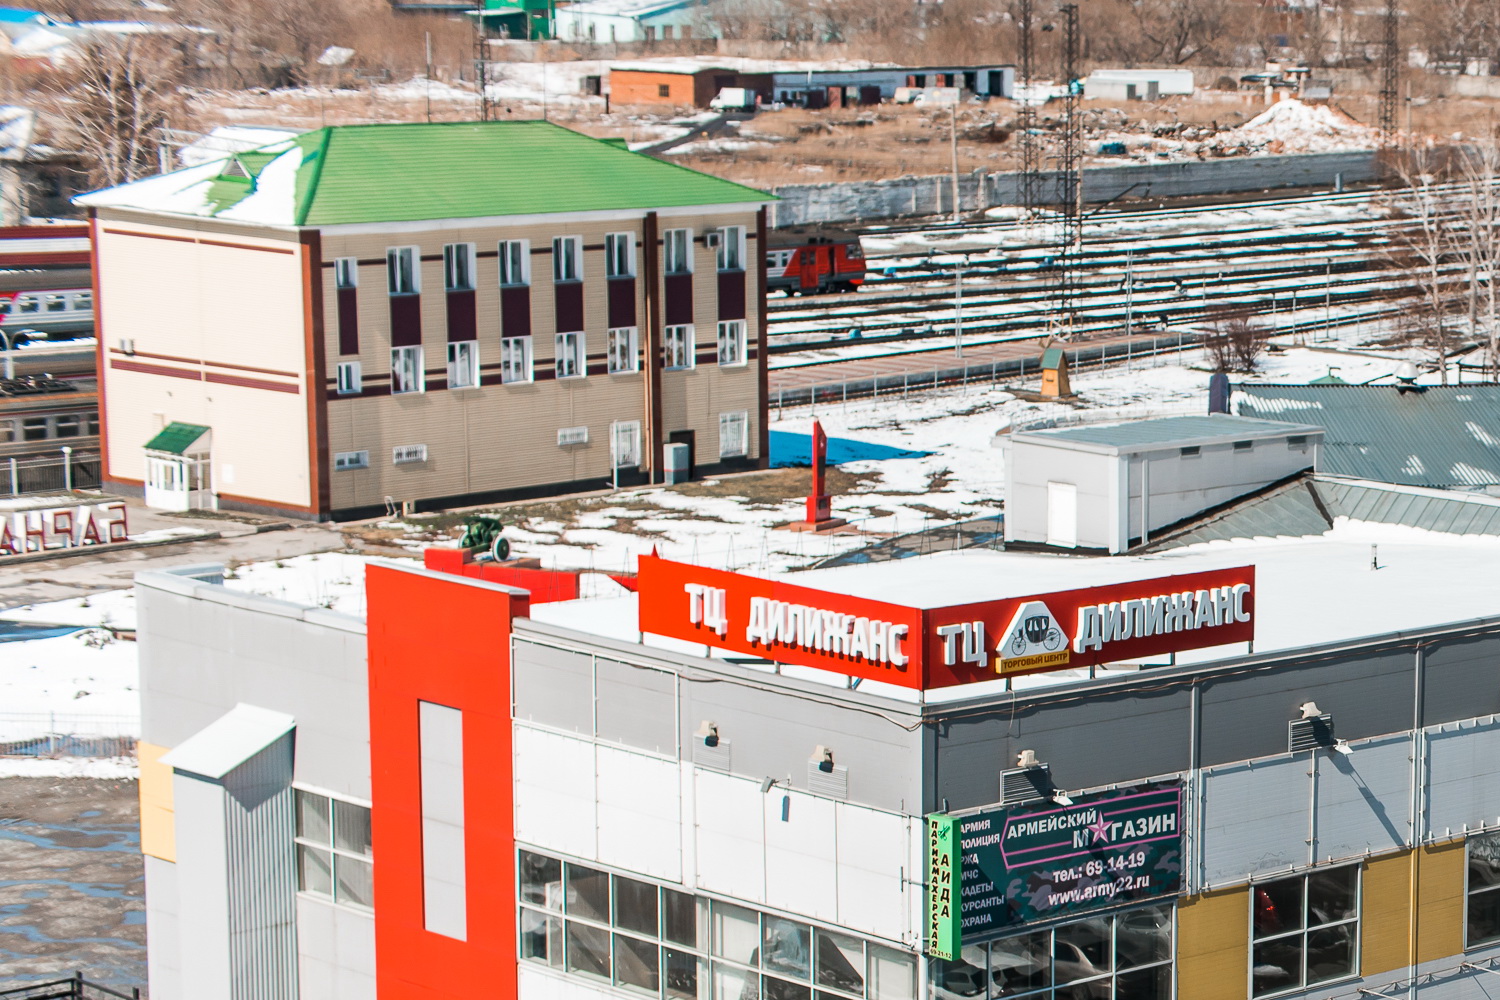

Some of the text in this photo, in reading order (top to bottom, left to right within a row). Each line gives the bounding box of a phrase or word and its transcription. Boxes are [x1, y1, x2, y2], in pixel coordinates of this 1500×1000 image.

[684, 582, 909, 666] ТЦ ДИЛИЖАНС
[937, 583, 1250, 668] ТЦ ДИЛИЖАНС
[1003, 652, 1068, 669] ТОРГОВЫЙ ЦЕНТР
[961, 819, 991, 834] АРМИЯ
[1007, 808, 1097, 840] АРМЕЙСКИЙ
[961, 833, 1000, 850] ПОЛИЦИЯ
[1053, 851, 1145, 884] тел.: 69-14-19
[931, 820, 940, 949] ПАРИКМАХЕРСКАЯ
[940, 853, 951, 918] АИДА
[1048, 875, 1150, 906] www.army22.ru
